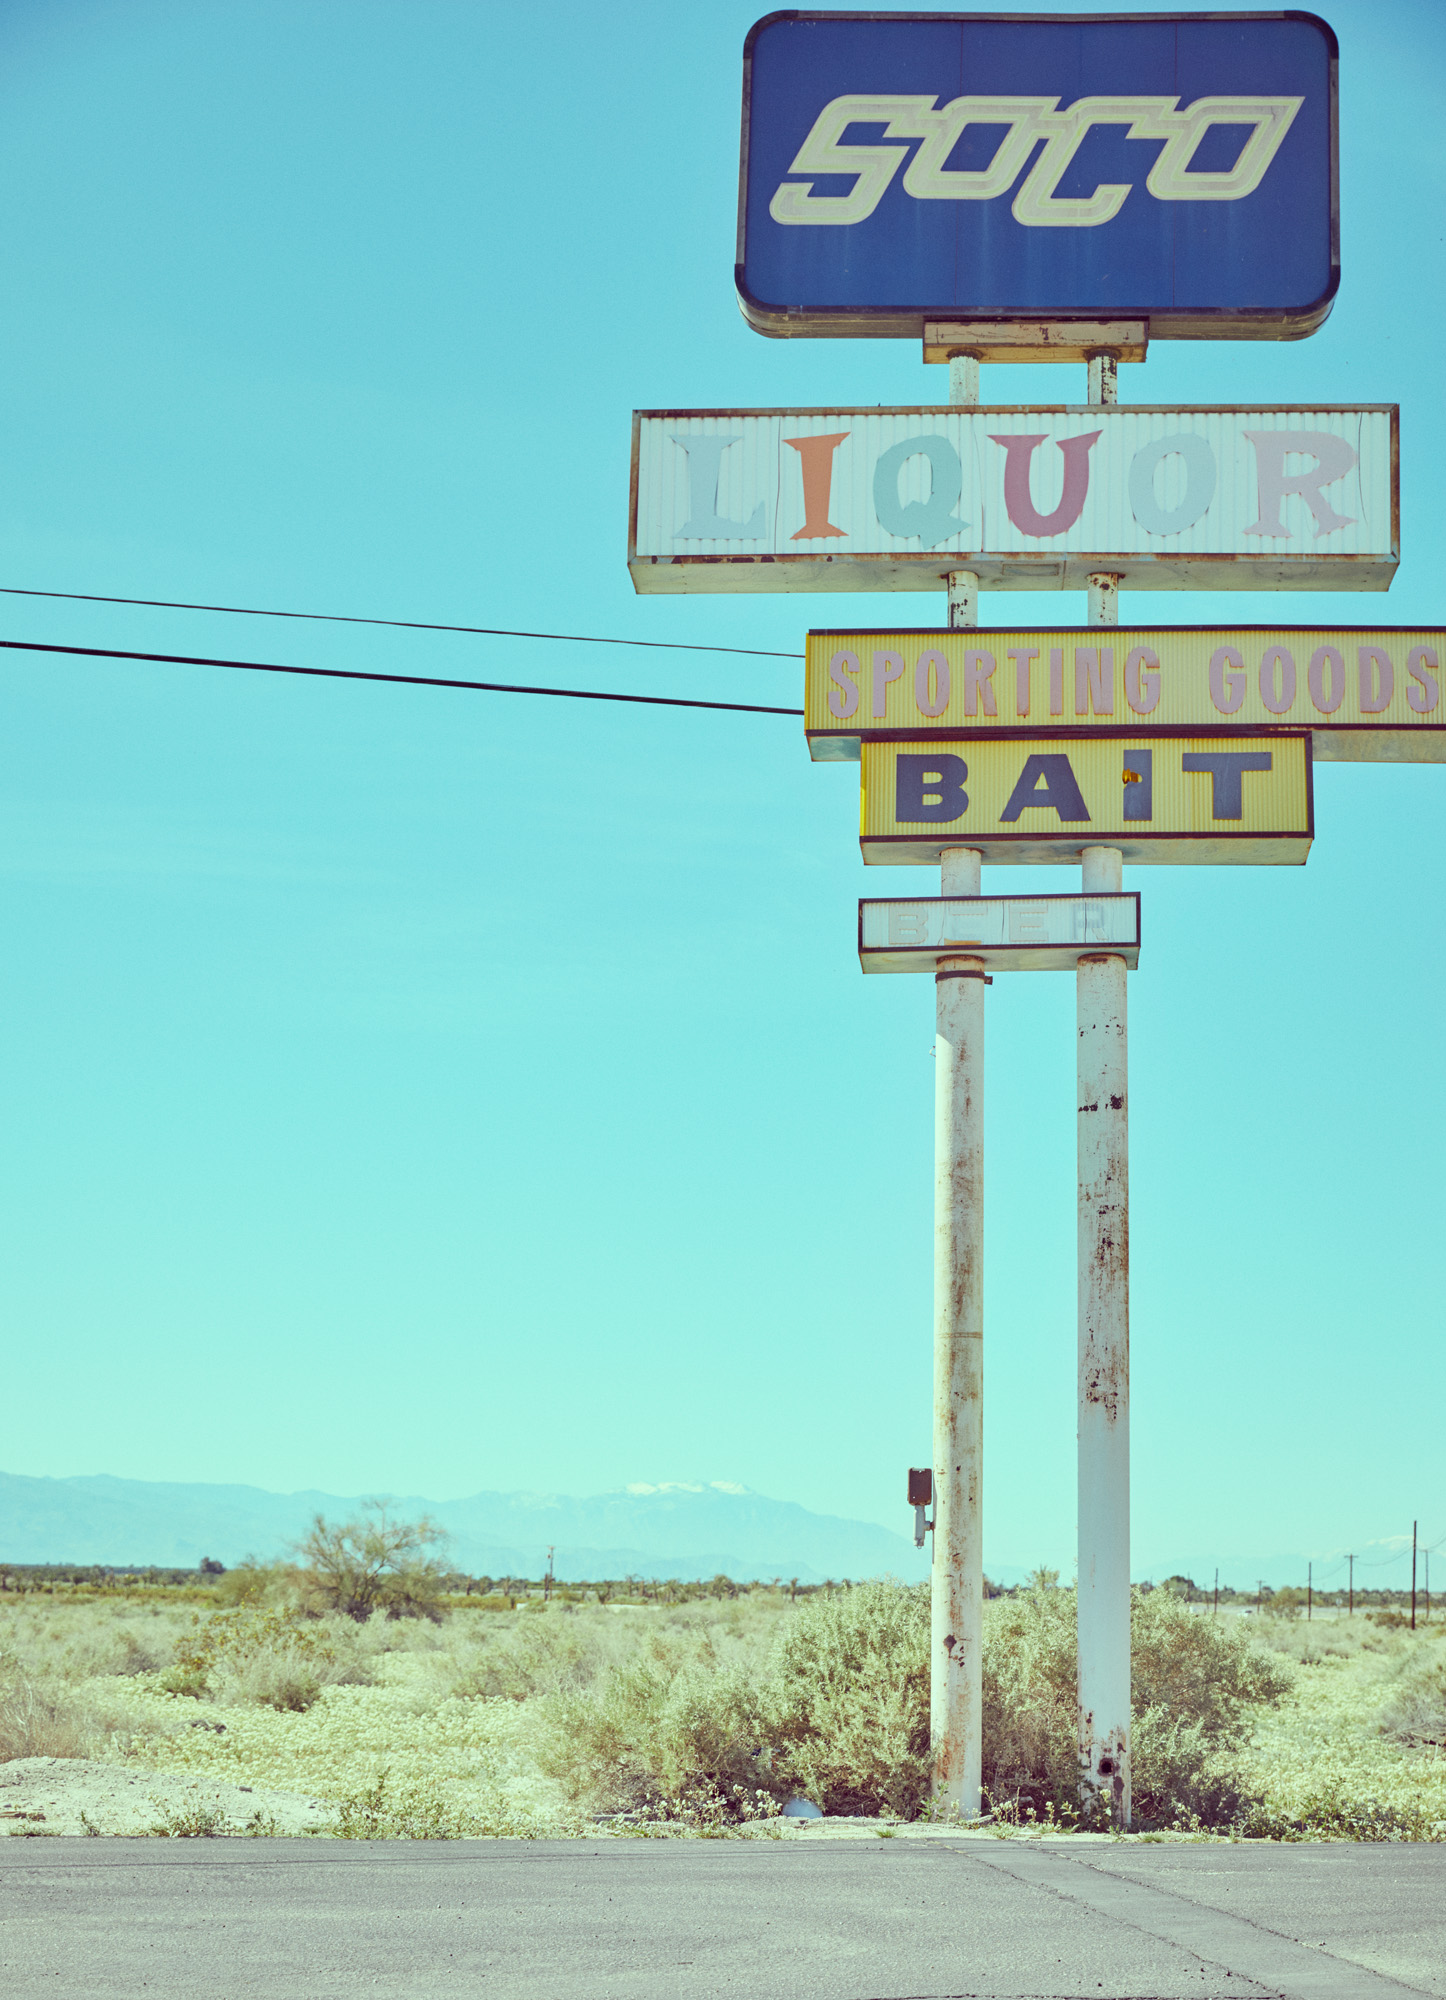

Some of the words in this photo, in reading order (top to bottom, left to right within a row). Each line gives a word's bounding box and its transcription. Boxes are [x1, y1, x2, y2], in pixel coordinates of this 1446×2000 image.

[769, 94, 1305, 226] SOCO
[668, 430, 1359, 550] LIQUOR
[827, 646, 1162, 718] SPORTING
[1208, 645, 1439, 714] GOODS
[895, 749, 1272, 823] BAIT
